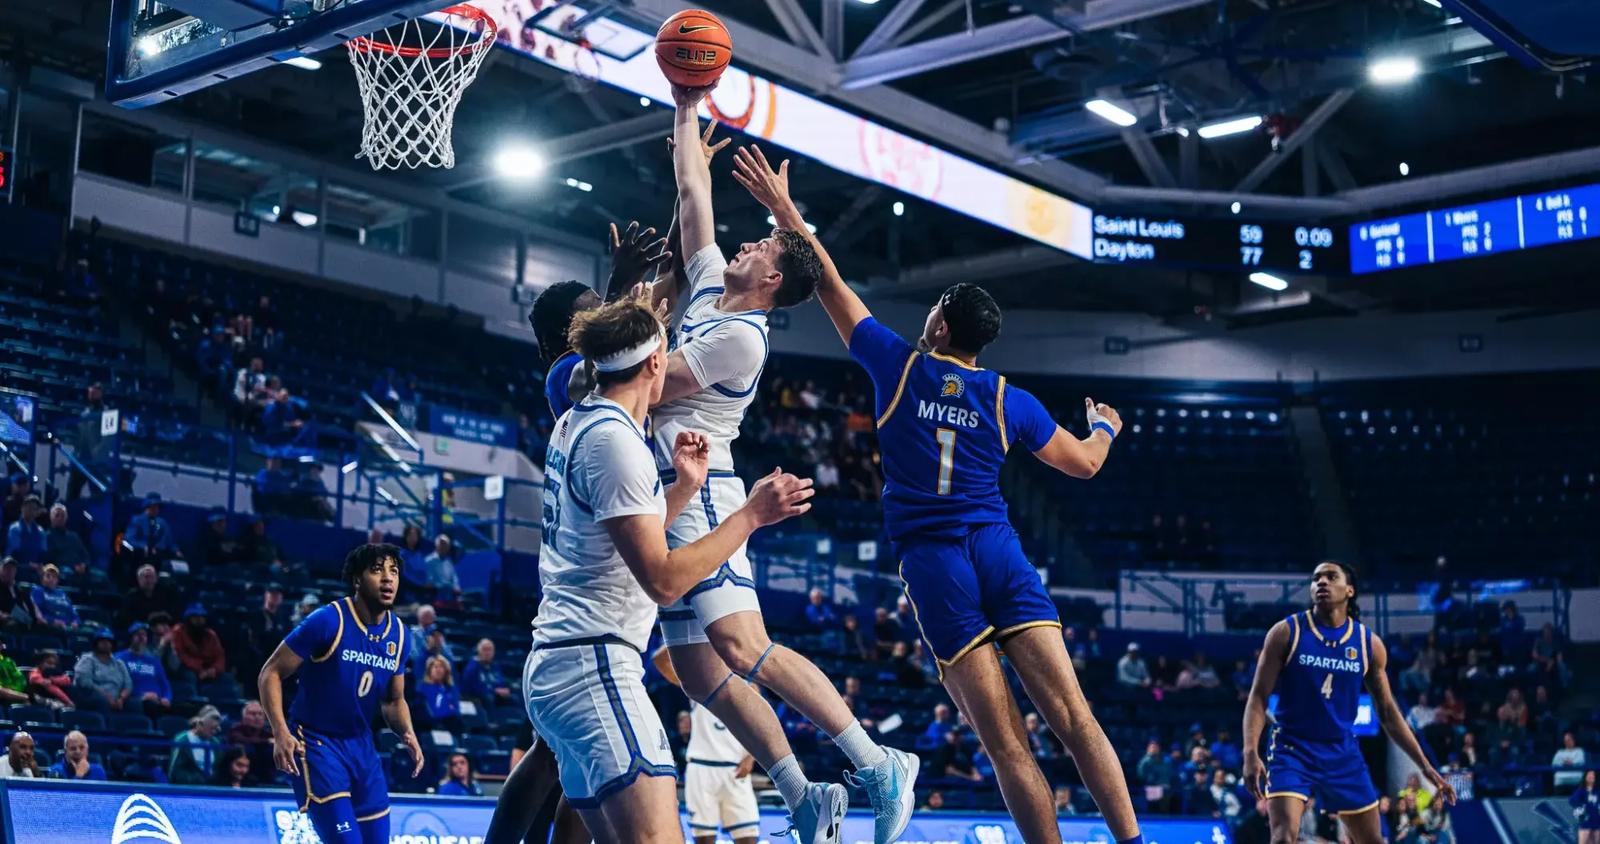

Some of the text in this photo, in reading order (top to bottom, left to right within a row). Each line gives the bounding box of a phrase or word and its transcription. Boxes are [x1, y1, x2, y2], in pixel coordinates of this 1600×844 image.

[676, 48, 716, 61] ELITE
[1094, 215, 1185, 239] Saint Louis
[1094, 238, 1155, 261] Dayton
[1240, 247, 1263, 265] 77
[1299, 250, 1312, 269] 2
[917, 400, 979, 428] MYERS
[936, 428, 957, 495] 1
[342, 649, 396, 671] SPARTANS
[1299, 654, 1360, 673] SPARTANS
[358, 670, 373, 697] 0
[1321, 673, 1333, 699] 4
